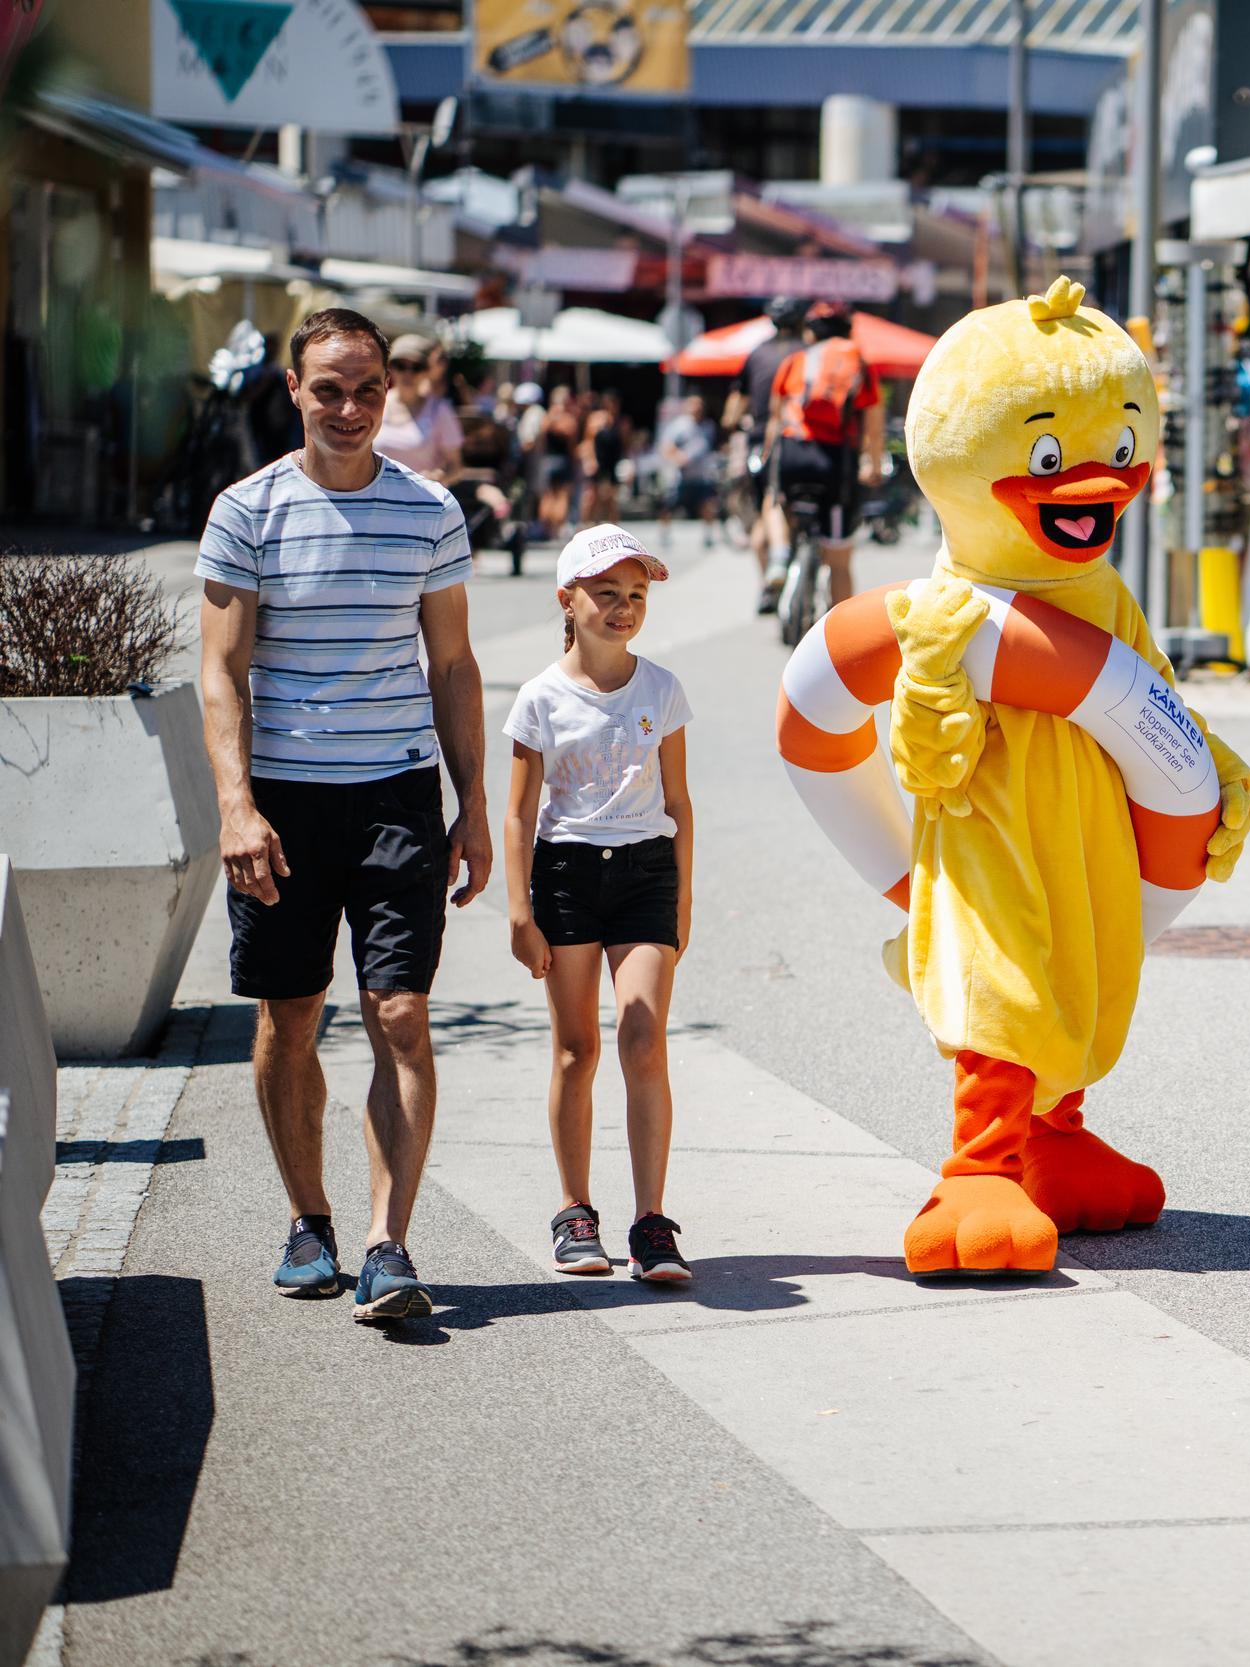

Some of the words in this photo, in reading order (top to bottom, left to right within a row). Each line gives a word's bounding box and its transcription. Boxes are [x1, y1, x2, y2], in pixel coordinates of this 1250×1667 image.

[1134, 720, 1184, 773] Südkärnten
[1139, 706, 1182, 751] Klopeiner
[1179, 747, 1196, 769] See
